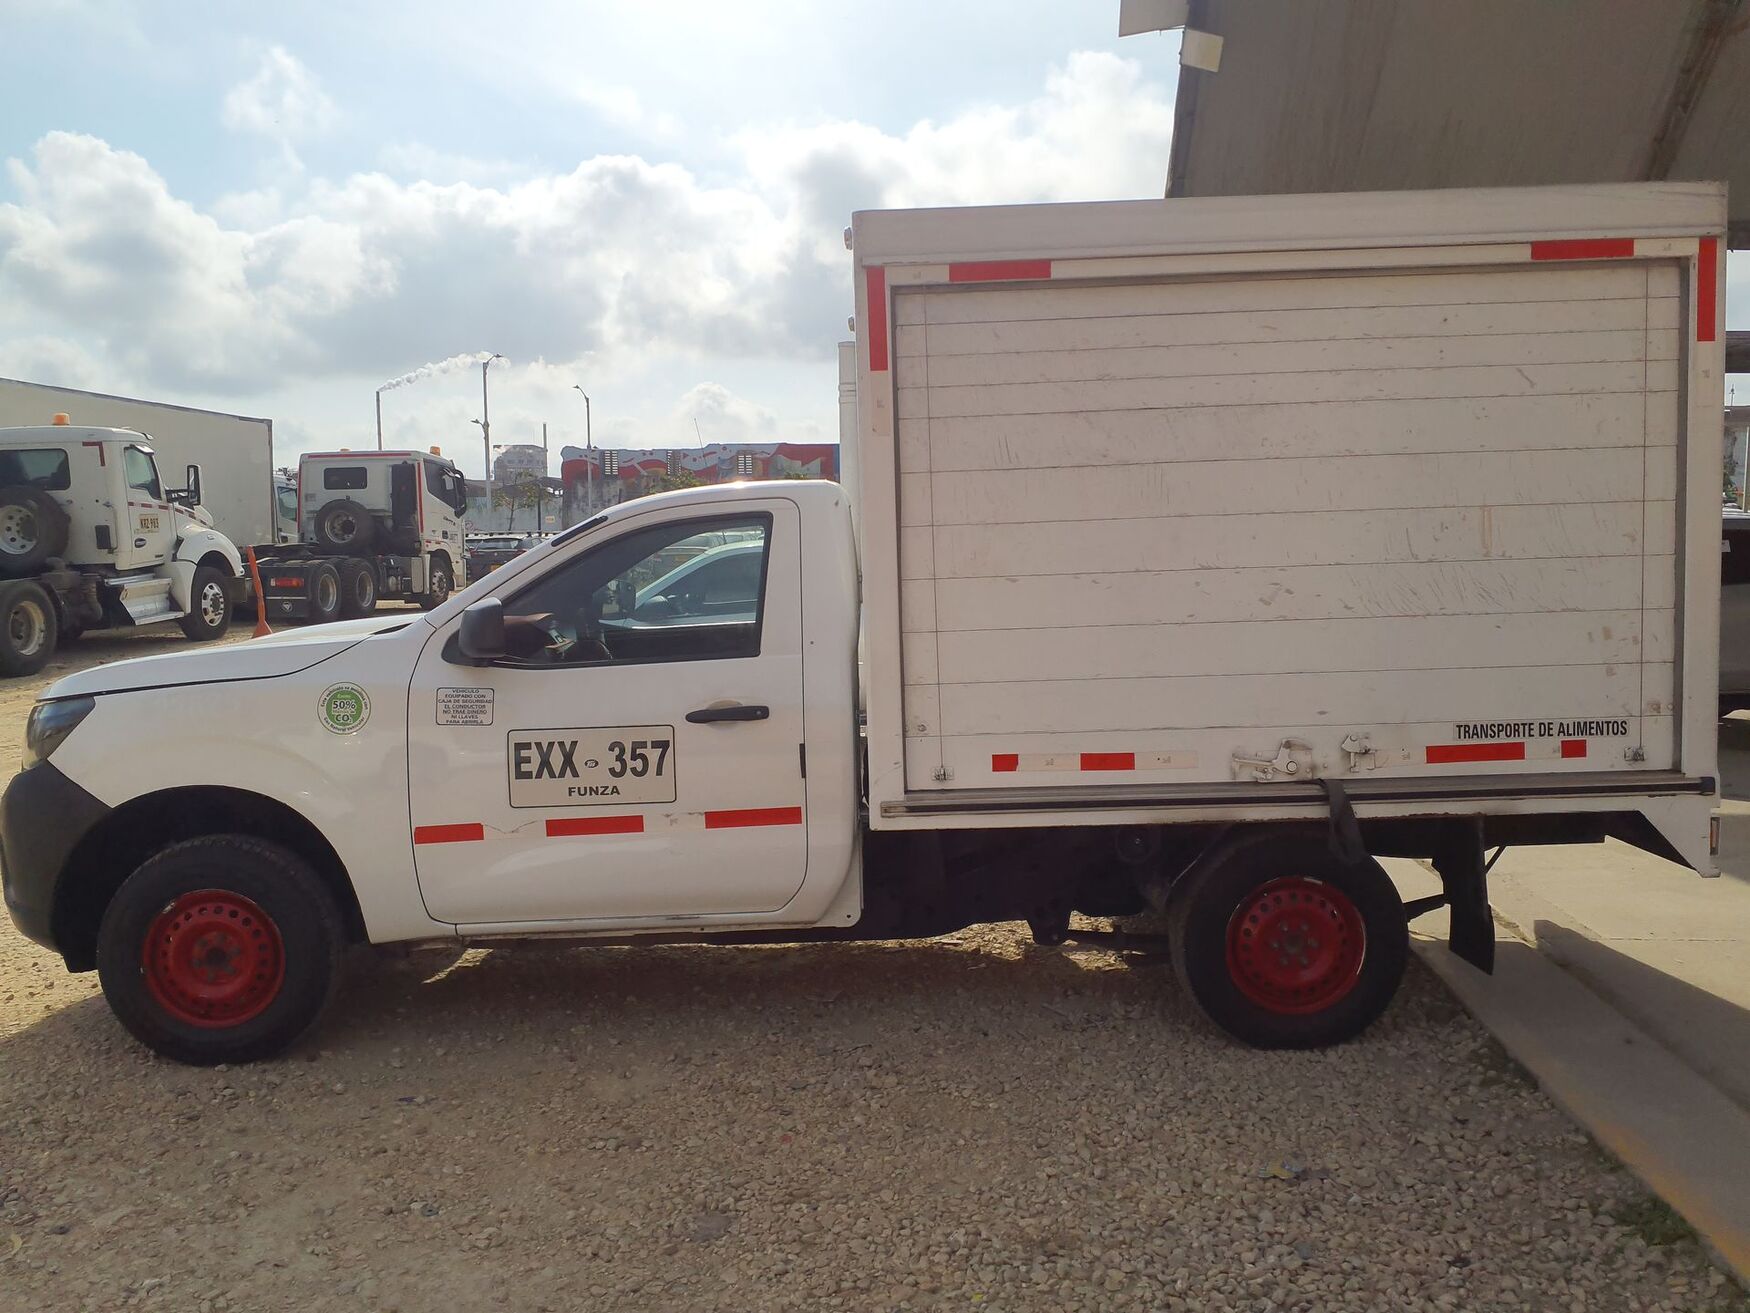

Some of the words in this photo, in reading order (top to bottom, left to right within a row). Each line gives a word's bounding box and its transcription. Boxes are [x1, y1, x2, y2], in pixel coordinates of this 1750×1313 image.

[333, 701, 356, 709] 50%
[1456, 722, 1535, 739] TRANSPORTE
[1538, 722, 1554, 737] DE
[1557, 720, 1628, 737] ALIMENTOS
[514, 740, 580, 780] EXX
[608, 740, 671, 778] 357
[568, 785, 621, 797] FUNZA
